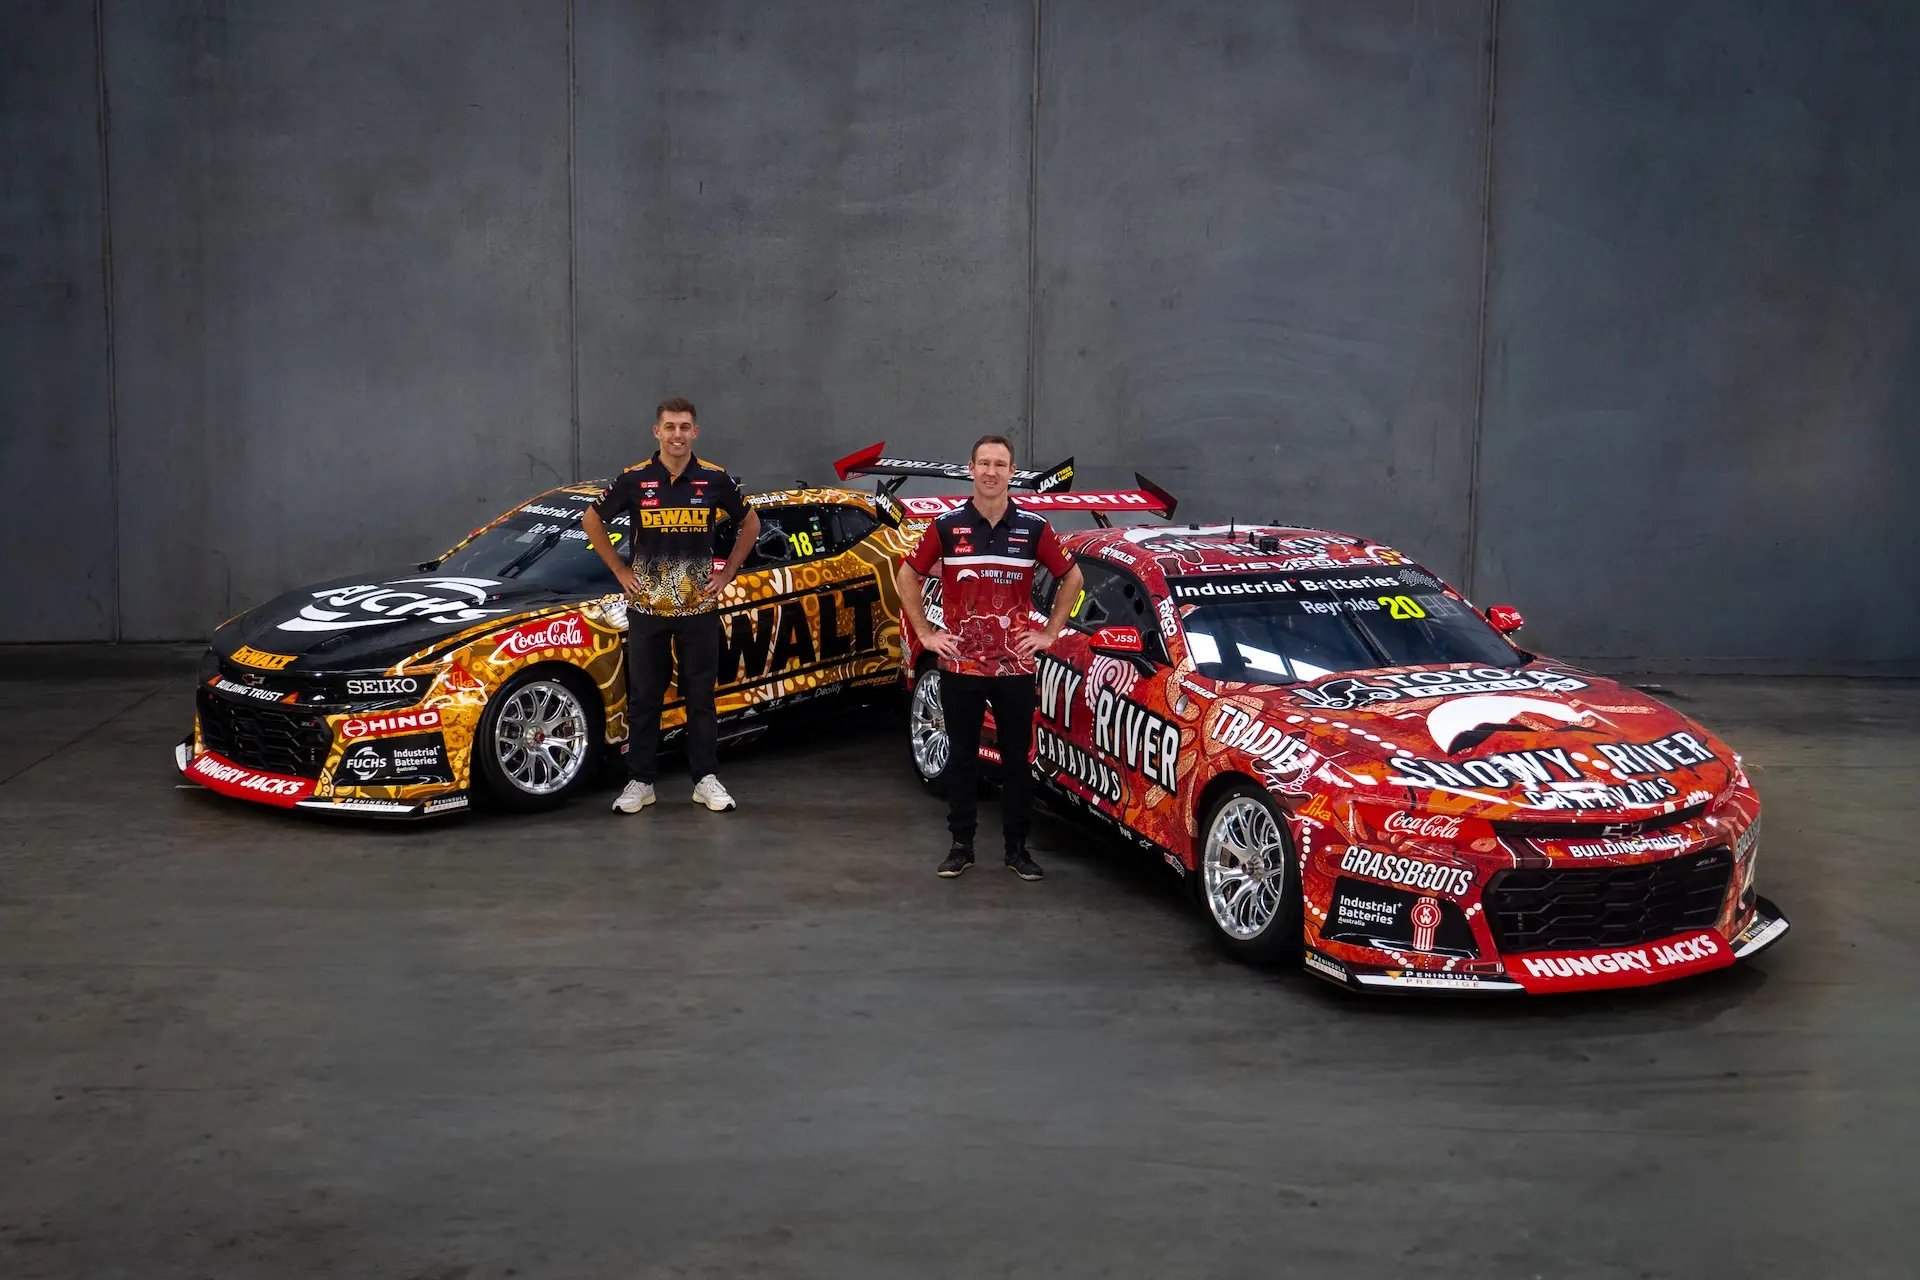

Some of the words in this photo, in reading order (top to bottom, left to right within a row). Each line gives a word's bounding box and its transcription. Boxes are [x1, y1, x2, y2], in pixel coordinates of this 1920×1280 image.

[1037, 474, 1059, 494] JAX
[876, 493, 891, 513] JAX
[528, 522, 546, 534] De
[640, 508, 710, 528] DeWALT
[788, 531, 814, 558] 18
[1099, 546, 1137, 565] REYNOLDS
[980, 569, 1003, 578] SNOWY
[1175, 580, 1296, 598] Industrial
[1300, 576, 1398, 592] Batteries
[1378, 596, 1427, 619] 20
[508, 616, 584, 654] Coca-Cola
[718, 583, 881, 687] WALT
[1114, 633, 1137, 644] JSSI
[215, 679, 251, 695] BUILDING
[247, 687, 285, 702] TRUST
[346, 677, 418, 695] SEIKO
[1181, 679, 1220, 700] DUNLOP
[369, 711, 440, 732] HINO
[1096, 688, 1179, 792] RIVER
[1211, 703, 1309, 774] TRADIE
[393, 746, 438, 758] Industrial
[394, 757, 438, 768] Batteries
[978, 747, 1001, 760] KENW
[1389, 747, 1581, 790] SNOWY
[1596, 731, 1715, 777] RIVER
[193, 755, 250, 783] HUNGRY
[346, 757, 387, 769] FUCHS
[1037, 727, 1122, 801] CARAVANS
[1384, 810, 1464, 839] Coca-Cola
[1568, 840, 1643, 858] BUILDING
[1645, 833, 1685, 850] TRUST
[1338, 905, 1394, 925] Batteries
[1340, 894, 1397, 915] Industrial
[1338, 916, 1366, 927] Australia
[1313, 953, 1346, 974] PENINSULA
[1521, 949, 1652, 978] HUNGRY
[1405, 970, 1480, 981] PENINSULA
